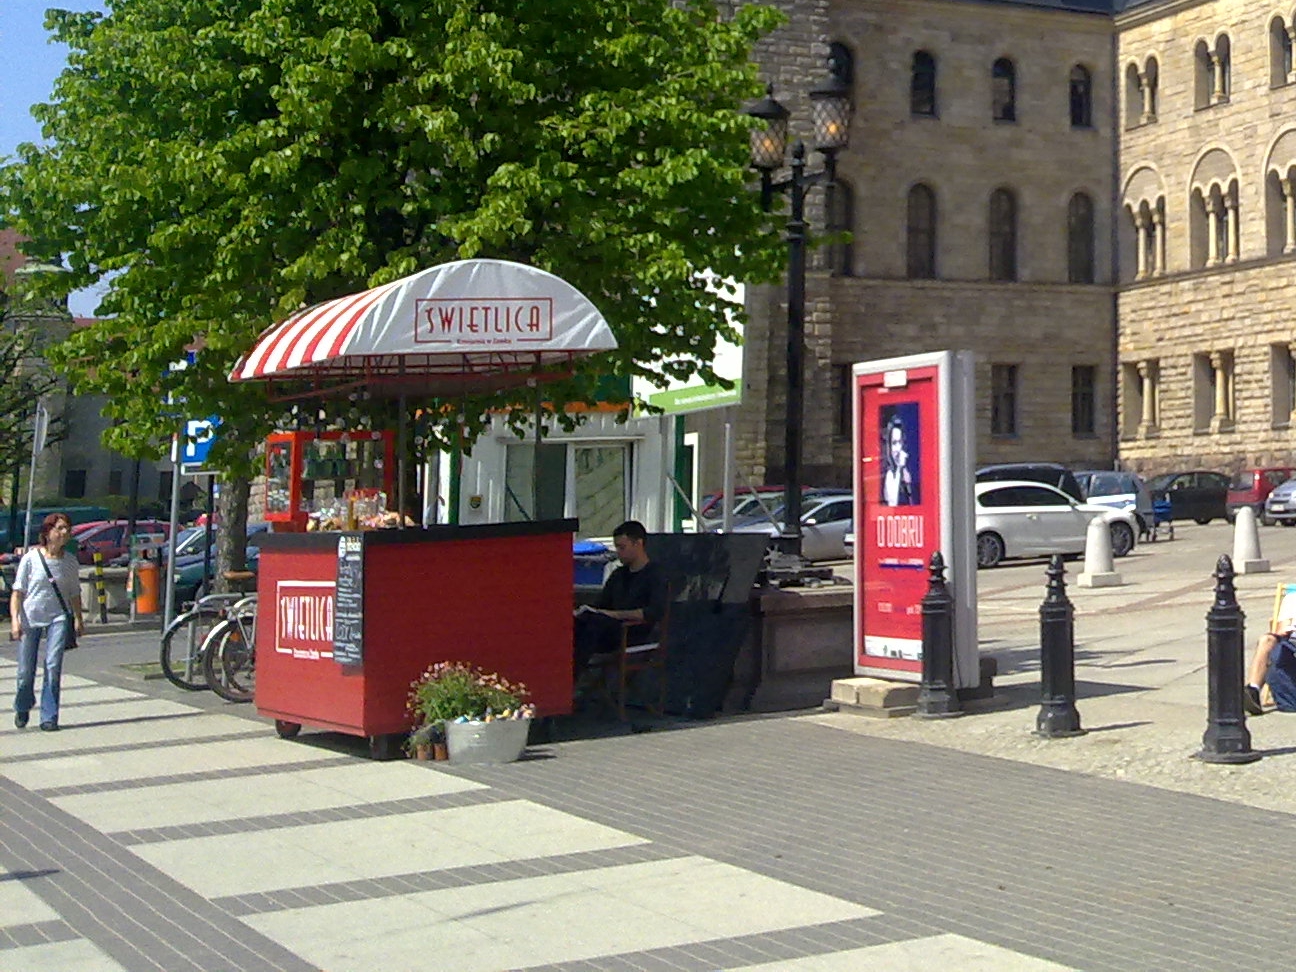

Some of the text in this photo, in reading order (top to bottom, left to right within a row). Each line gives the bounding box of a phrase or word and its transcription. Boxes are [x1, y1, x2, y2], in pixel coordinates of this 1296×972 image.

[186, 419, 214, 457] P
[876, 515, 924, 548] O DOBRU
